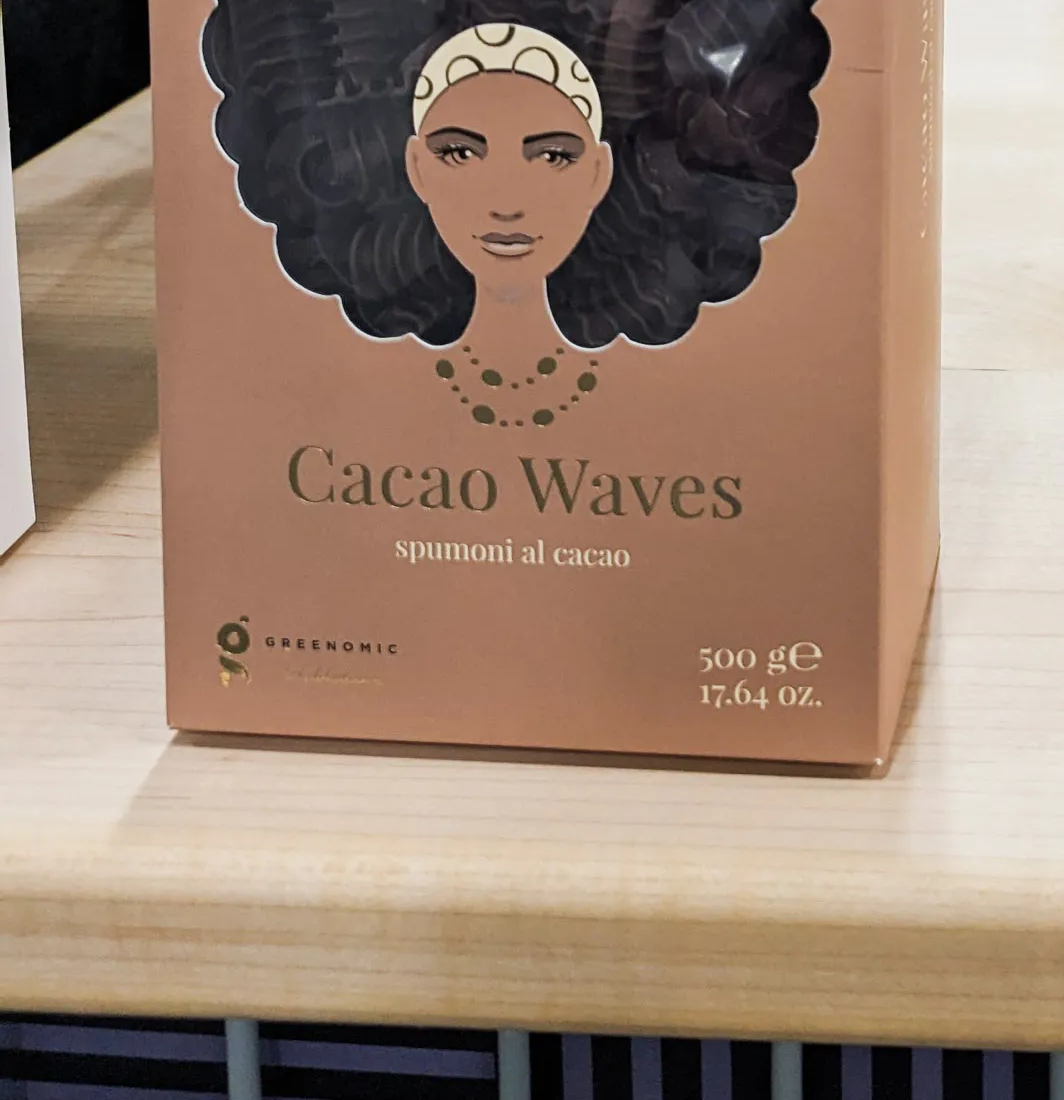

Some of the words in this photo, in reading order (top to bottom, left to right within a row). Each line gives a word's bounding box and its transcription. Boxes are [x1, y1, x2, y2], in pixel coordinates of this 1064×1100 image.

[287, 444, 499, 514] Cacao
[517, 455, 745, 520] Waves
[394, 538, 514, 565] spumoni
[521, 540, 545, 565] al
[552, 544, 631, 569] cacao
[264, 635, 399, 655] GREENOMIC
[698, 646, 757, 673] 500
[698, 678, 770, 711] 17.64
[778, 684, 823, 708] oz.
